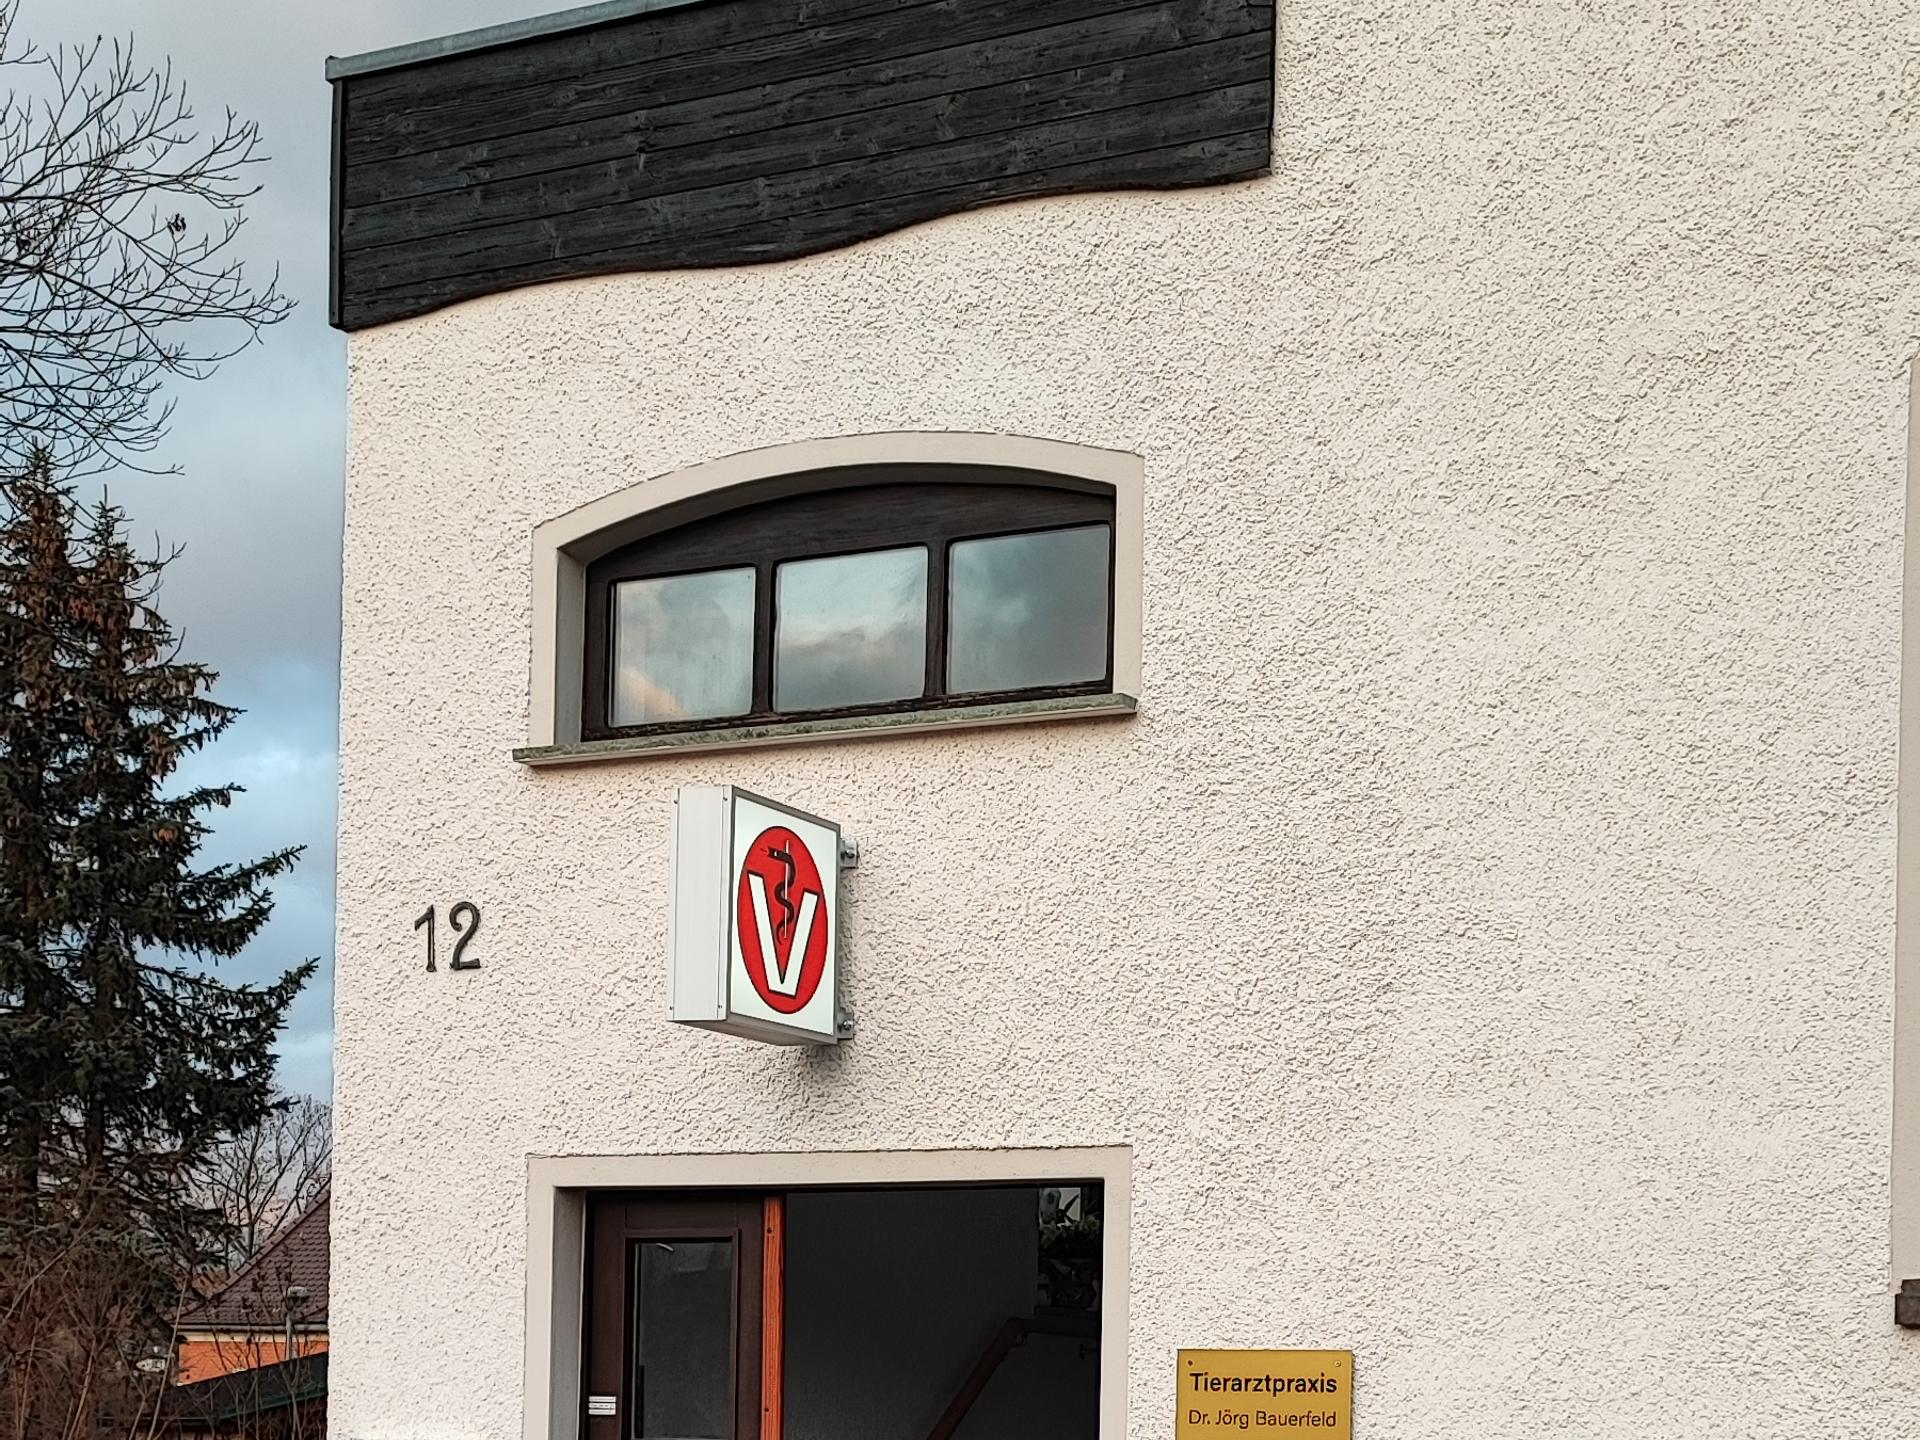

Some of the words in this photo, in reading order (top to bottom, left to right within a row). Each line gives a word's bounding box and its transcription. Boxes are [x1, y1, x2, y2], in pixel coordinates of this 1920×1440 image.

[414, 901, 481, 972] 12
[747, 872, 819, 997] V
[1190, 1372, 1337, 1397] Tierarztpraxis
[1188, 1409, 1210, 1425] Dr.
[1215, 1409, 1249, 1429] Jörg
[1255, 1410, 1336, 1427] Bauerfeld
